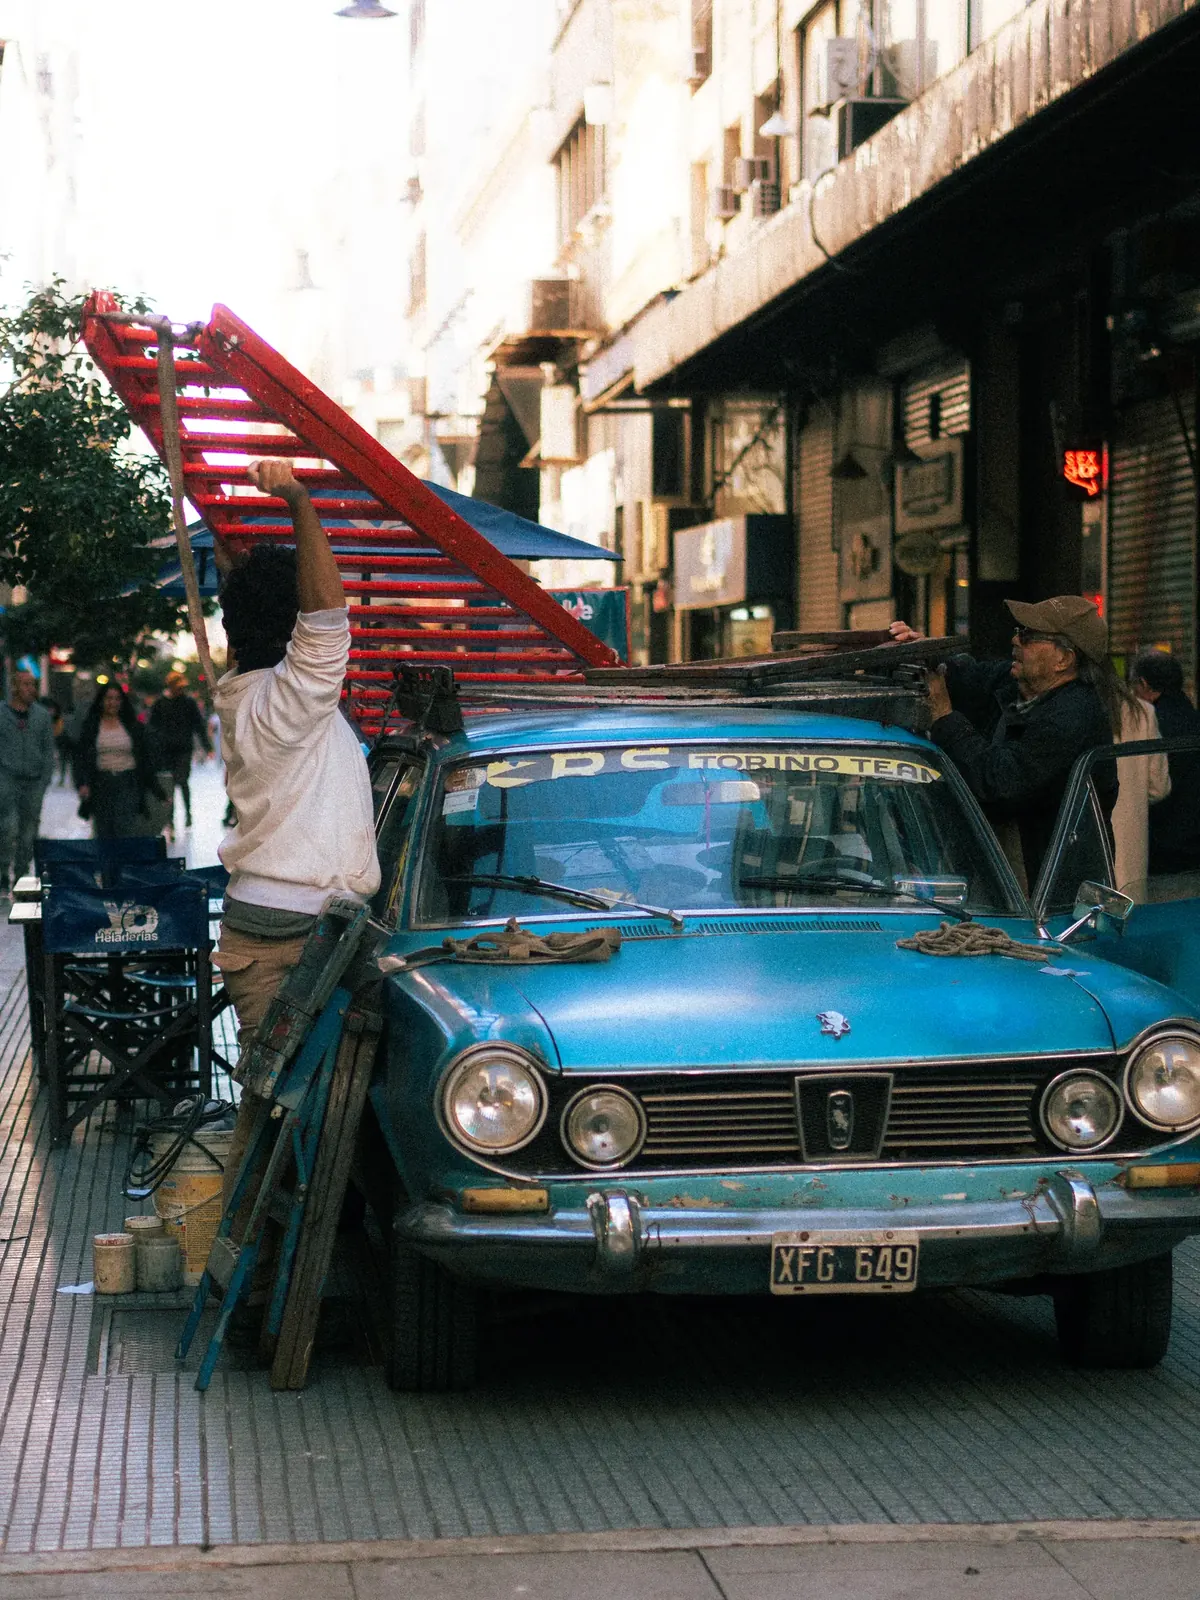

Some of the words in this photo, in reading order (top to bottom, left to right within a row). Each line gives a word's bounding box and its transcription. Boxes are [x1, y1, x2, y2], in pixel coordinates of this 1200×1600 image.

[1064, 450, 1097, 466] SEX
[695, 755, 840, 771] TORINO
[778, 1247, 835, 1282] XFG
[855, 1247, 914, 1282] 649
